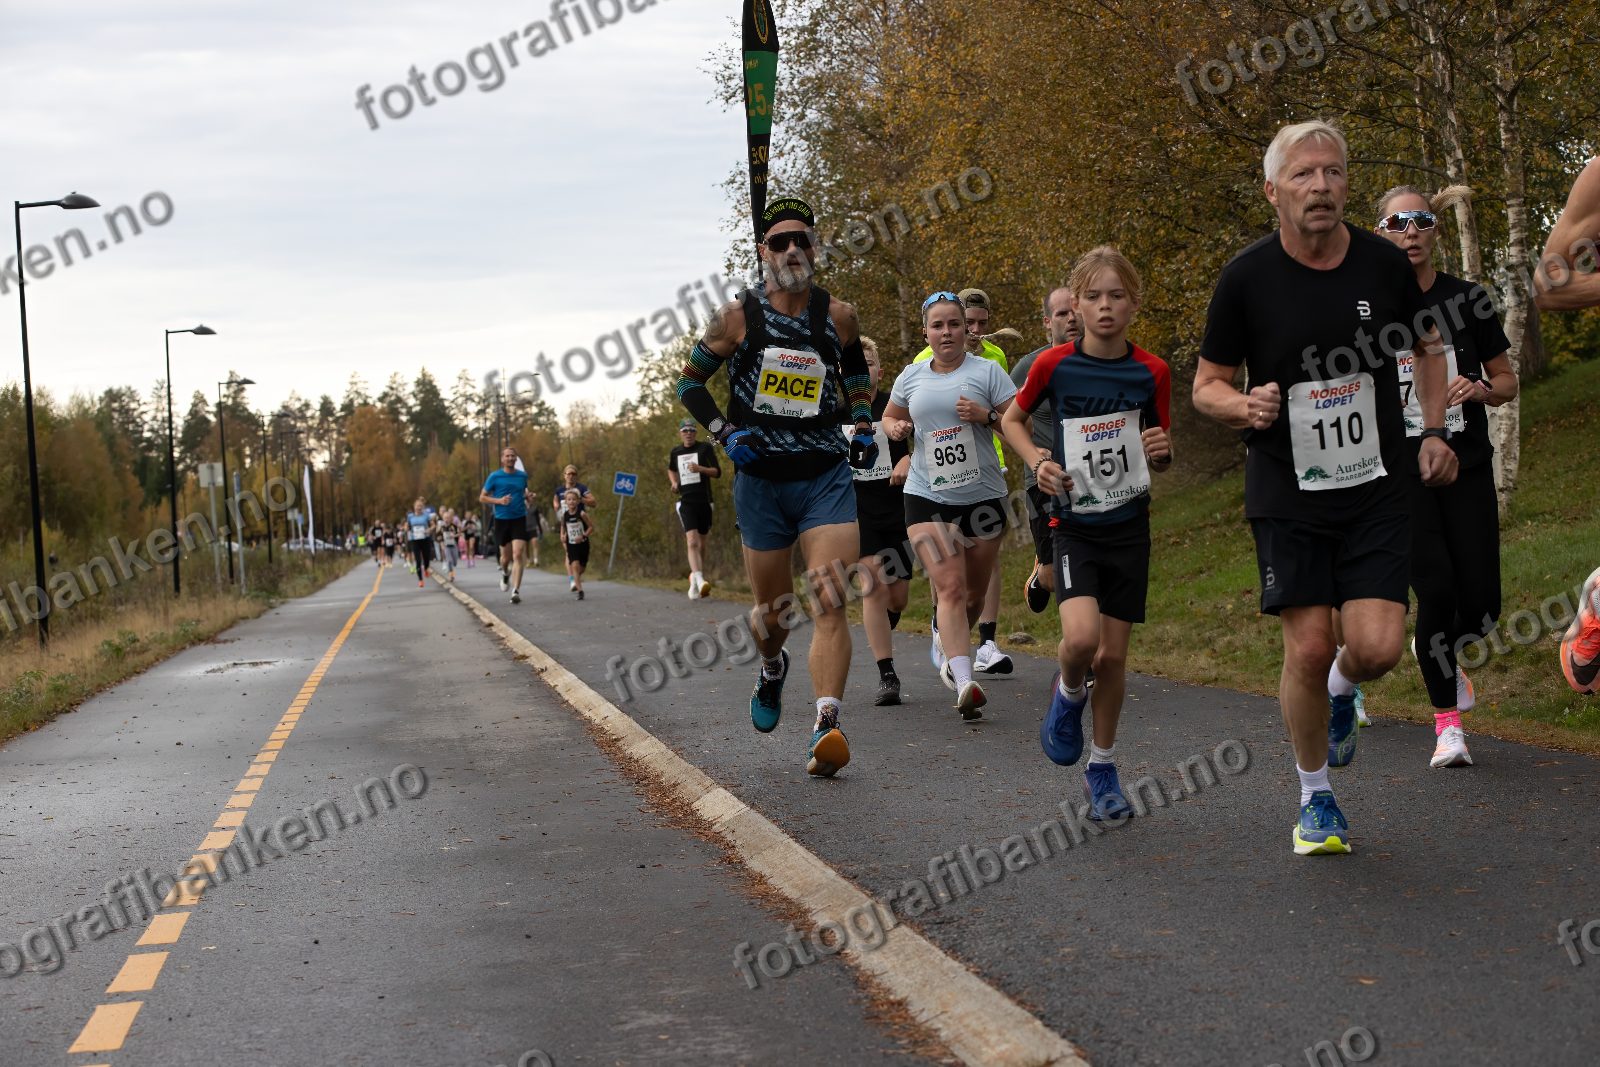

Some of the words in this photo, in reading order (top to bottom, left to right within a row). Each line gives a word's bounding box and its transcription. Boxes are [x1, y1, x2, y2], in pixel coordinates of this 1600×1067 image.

[778, 353, 817, 365] NORGES
[780, 360, 811, 371] LØPET
[764, 373, 817, 399] PACE
[1308, 381, 1361, 400] NORGES
[1315, 393, 1356, 410] LØPET
[932, 426, 962, 438] NORGES
[1080, 418, 1126, 434] NORGES
[1312, 411, 1364, 450] 110
[935, 433, 958, 443] LØPET
[1085, 428, 1122, 443] LØPET
[934, 443, 967, 467] 963
[1082, 444, 1129, 479] 151
[1335, 455, 1380, 476] Aurskog
[950, 467, 979, 481] Aurskog
